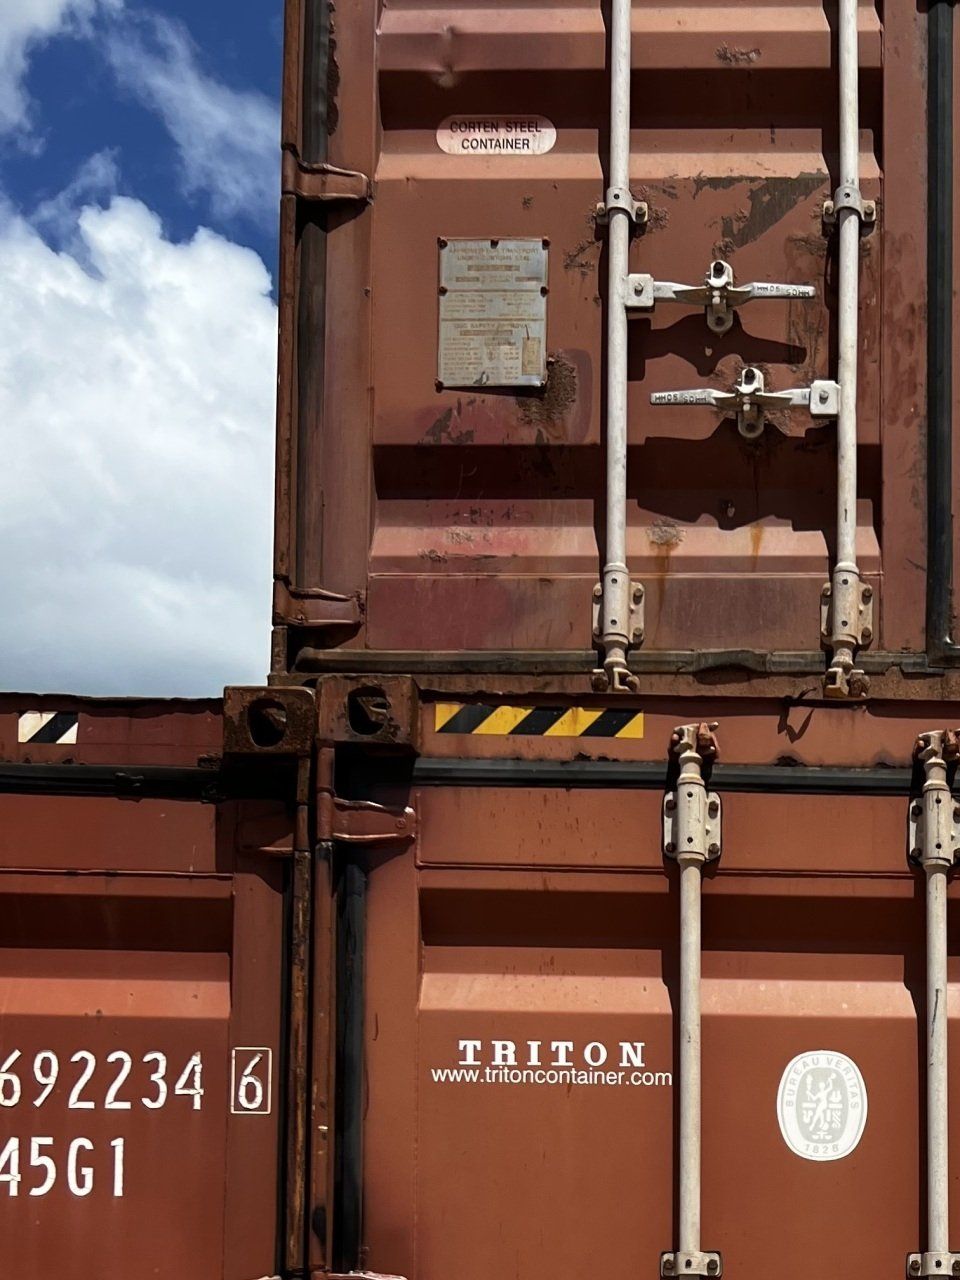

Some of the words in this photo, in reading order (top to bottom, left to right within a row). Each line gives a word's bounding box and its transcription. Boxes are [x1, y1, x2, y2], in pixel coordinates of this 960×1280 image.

[450, 121, 499, 133] CORTEN
[505, 121, 542, 133] STEEL
[461, 138, 530, 150] CONTAINER
[459, 1040, 646, 1067] TRITON
[0, 1049, 204, 1110] 692234
[238, 1053, 263, 1110] 6
[431, 1066, 673, 1086] www.tritoncontainer.com
[785, 1056, 820, 1108] BUREAU
[826, 1056, 860, 1110] VERITAS
[0, 1136, 124, 1197] 45G1
